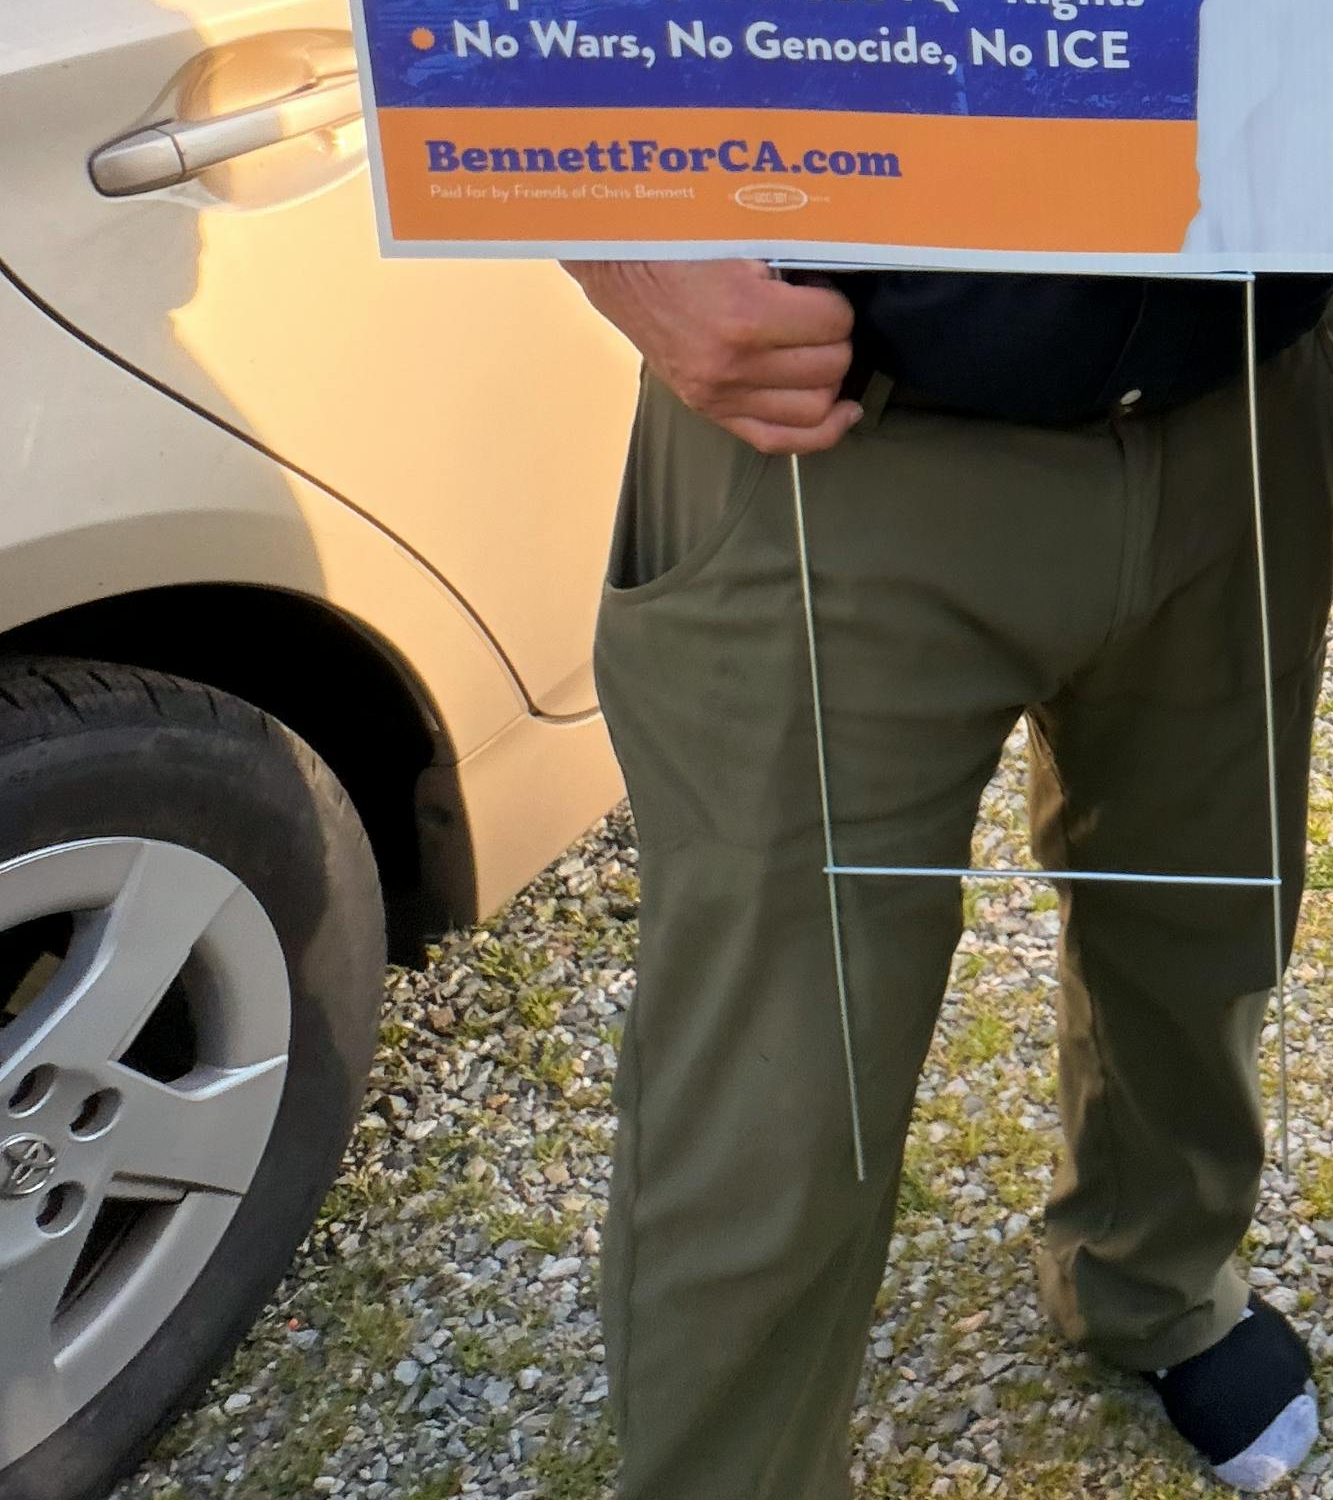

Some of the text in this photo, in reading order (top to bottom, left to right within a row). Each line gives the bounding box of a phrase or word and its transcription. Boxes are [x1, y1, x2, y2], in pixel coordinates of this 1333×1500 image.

[453, 19, 1130, 75] No Wars, No Genocide, No ICE
[425, 139, 902, 178] BennettForCA.com
[430, 183, 695, 203] Paid for by Friends of Chris Bennett
